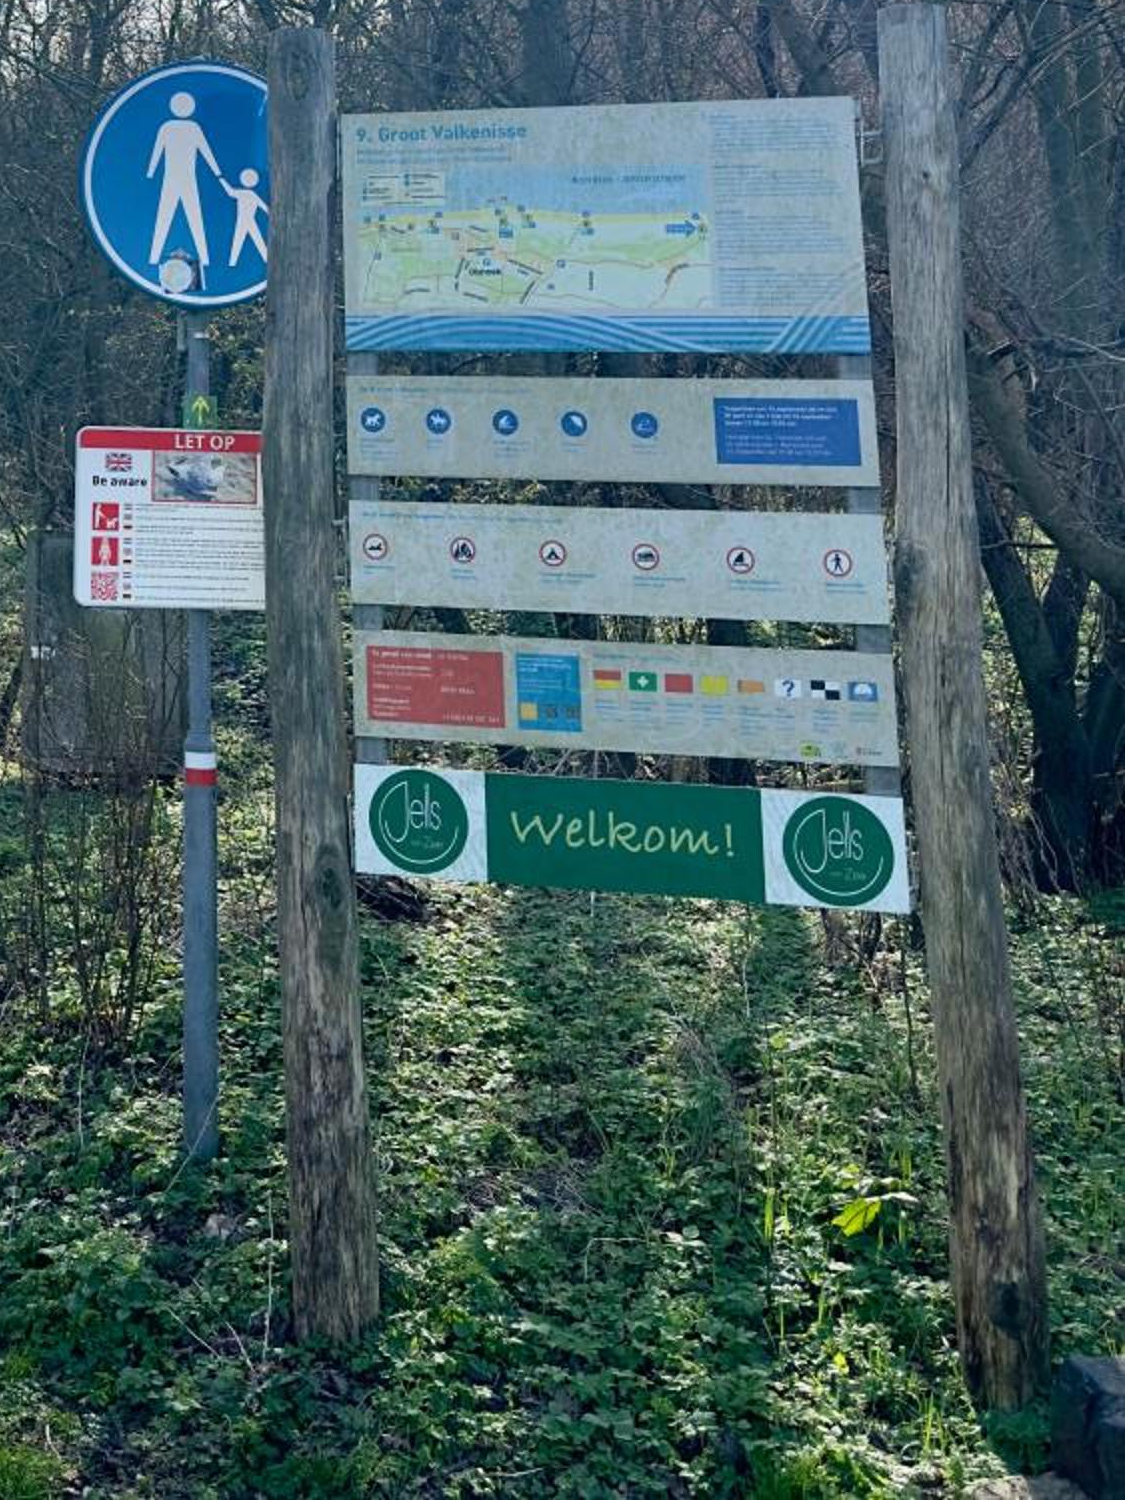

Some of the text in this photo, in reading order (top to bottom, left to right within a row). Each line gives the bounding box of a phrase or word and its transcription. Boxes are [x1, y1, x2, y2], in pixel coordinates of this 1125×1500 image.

[356, 123, 528, 143] 9. Groot Valkenisse
[175, 434, 236, 450] LET OP
[92, 475, 148, 488] Be aware
[510, 808, 735, 857] Welkom!
